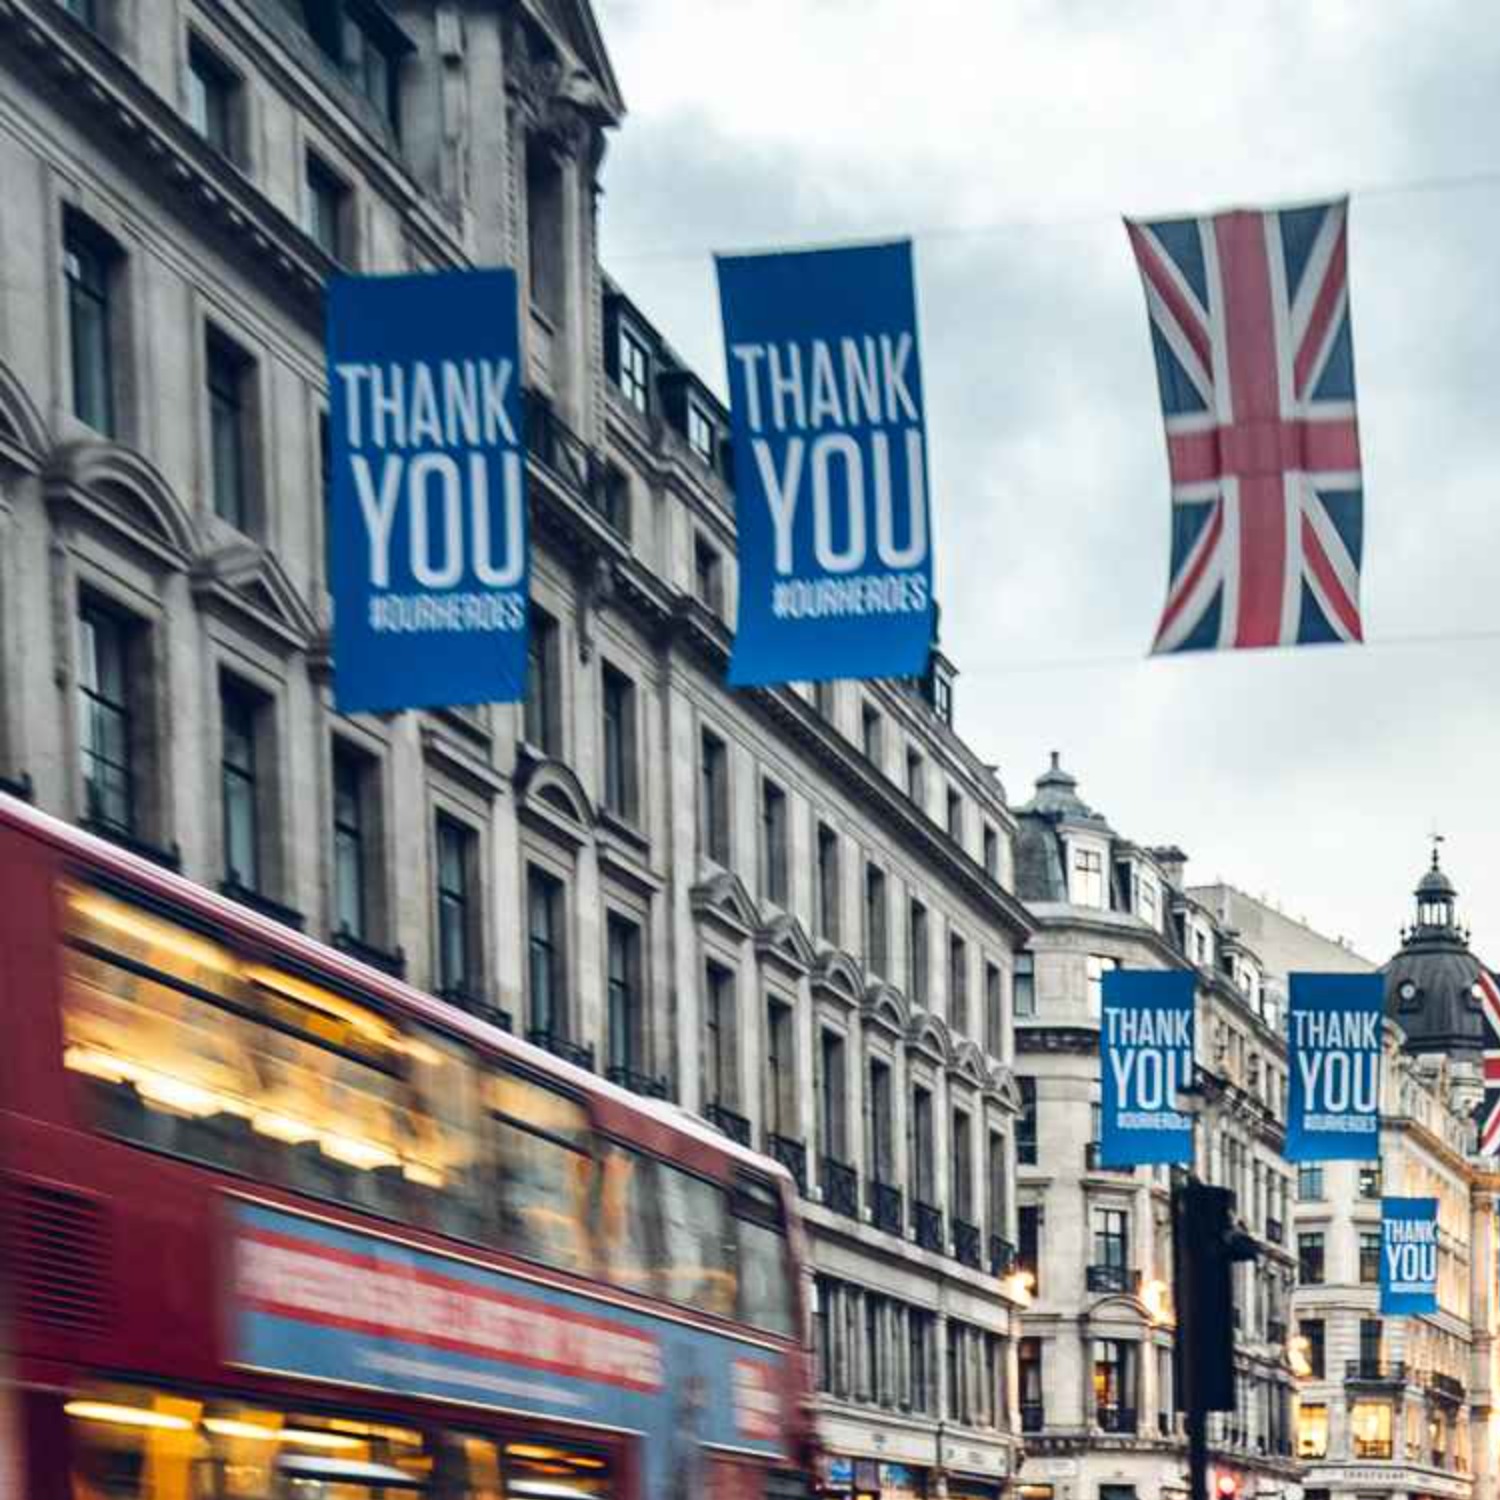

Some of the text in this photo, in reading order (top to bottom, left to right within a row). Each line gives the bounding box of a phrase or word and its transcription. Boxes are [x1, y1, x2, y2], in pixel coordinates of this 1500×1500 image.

[337, 358, 518, 448] THANK
[732, 332, 919, 433] THANK
[351, 451, 524, 589] YOU
[753, 428, 927, 575] YOU
[369, 594, 524, 632] #OURHEROES
[773, 573, 927, 620] #OURHEROES
[1104, 1007, 1191, 1046] THANK
[1292, 1010, 1378, 1049] THANK
[1109, 1048, 1191, 1110] YOU
[1298, 1050, 1378, 1112] YOU
[1383, 1220, 1436, 1243] THANK
[1387, 1244, 1436, 1280] YOU
